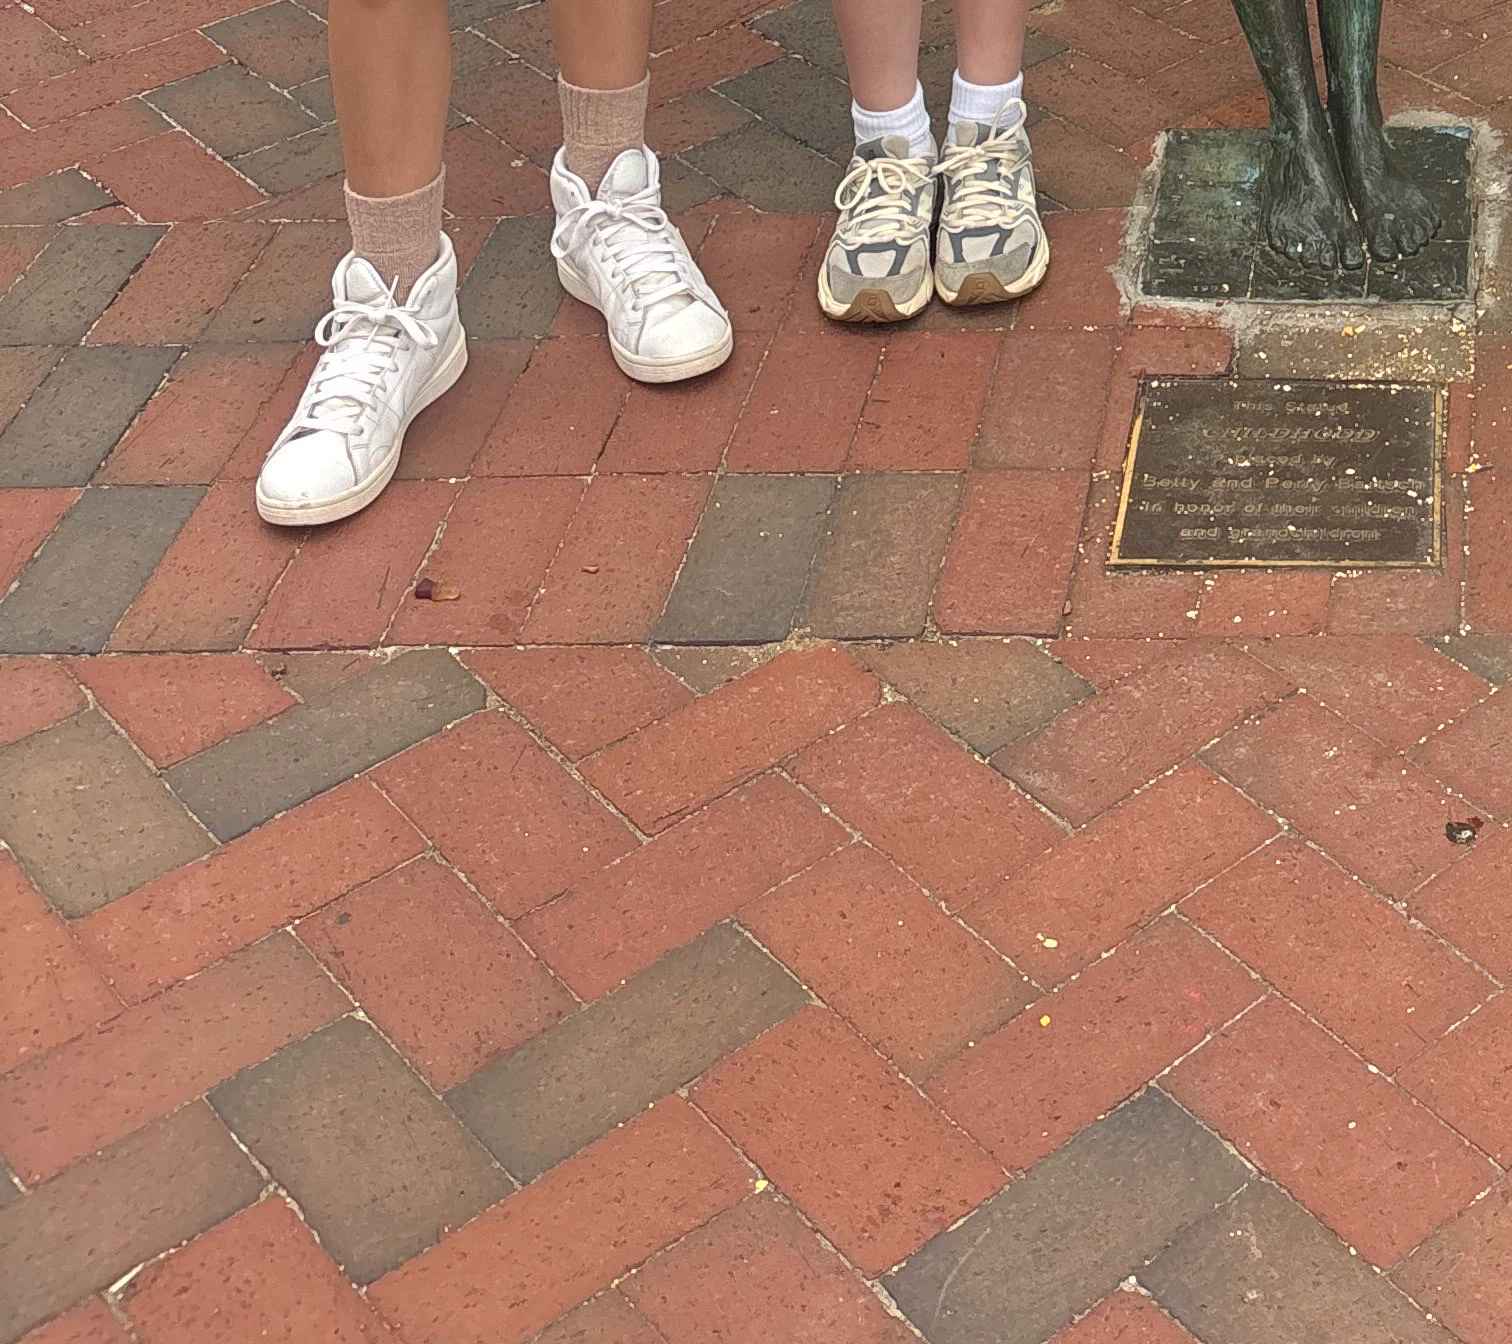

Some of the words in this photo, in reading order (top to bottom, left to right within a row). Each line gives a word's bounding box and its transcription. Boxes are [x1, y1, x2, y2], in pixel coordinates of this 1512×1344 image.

[1233, 400, 1273, 412] This
[1203, 427, 1380, 442] CHILDHOOD
[1313, 453, 1337, 467] by
[1142, 474, 1201, 491] Betty
[1211, 476, 1253, 490] and
[1264, 476, 1327, 492] Perry
[1174, 502, 1237, 514] honor
[1244, 502, 1264, 513] of
[1272, 503, 1320, 515] their
[1331, 504, 1416, 515] children
[1179, 526, 1219, 538] and
